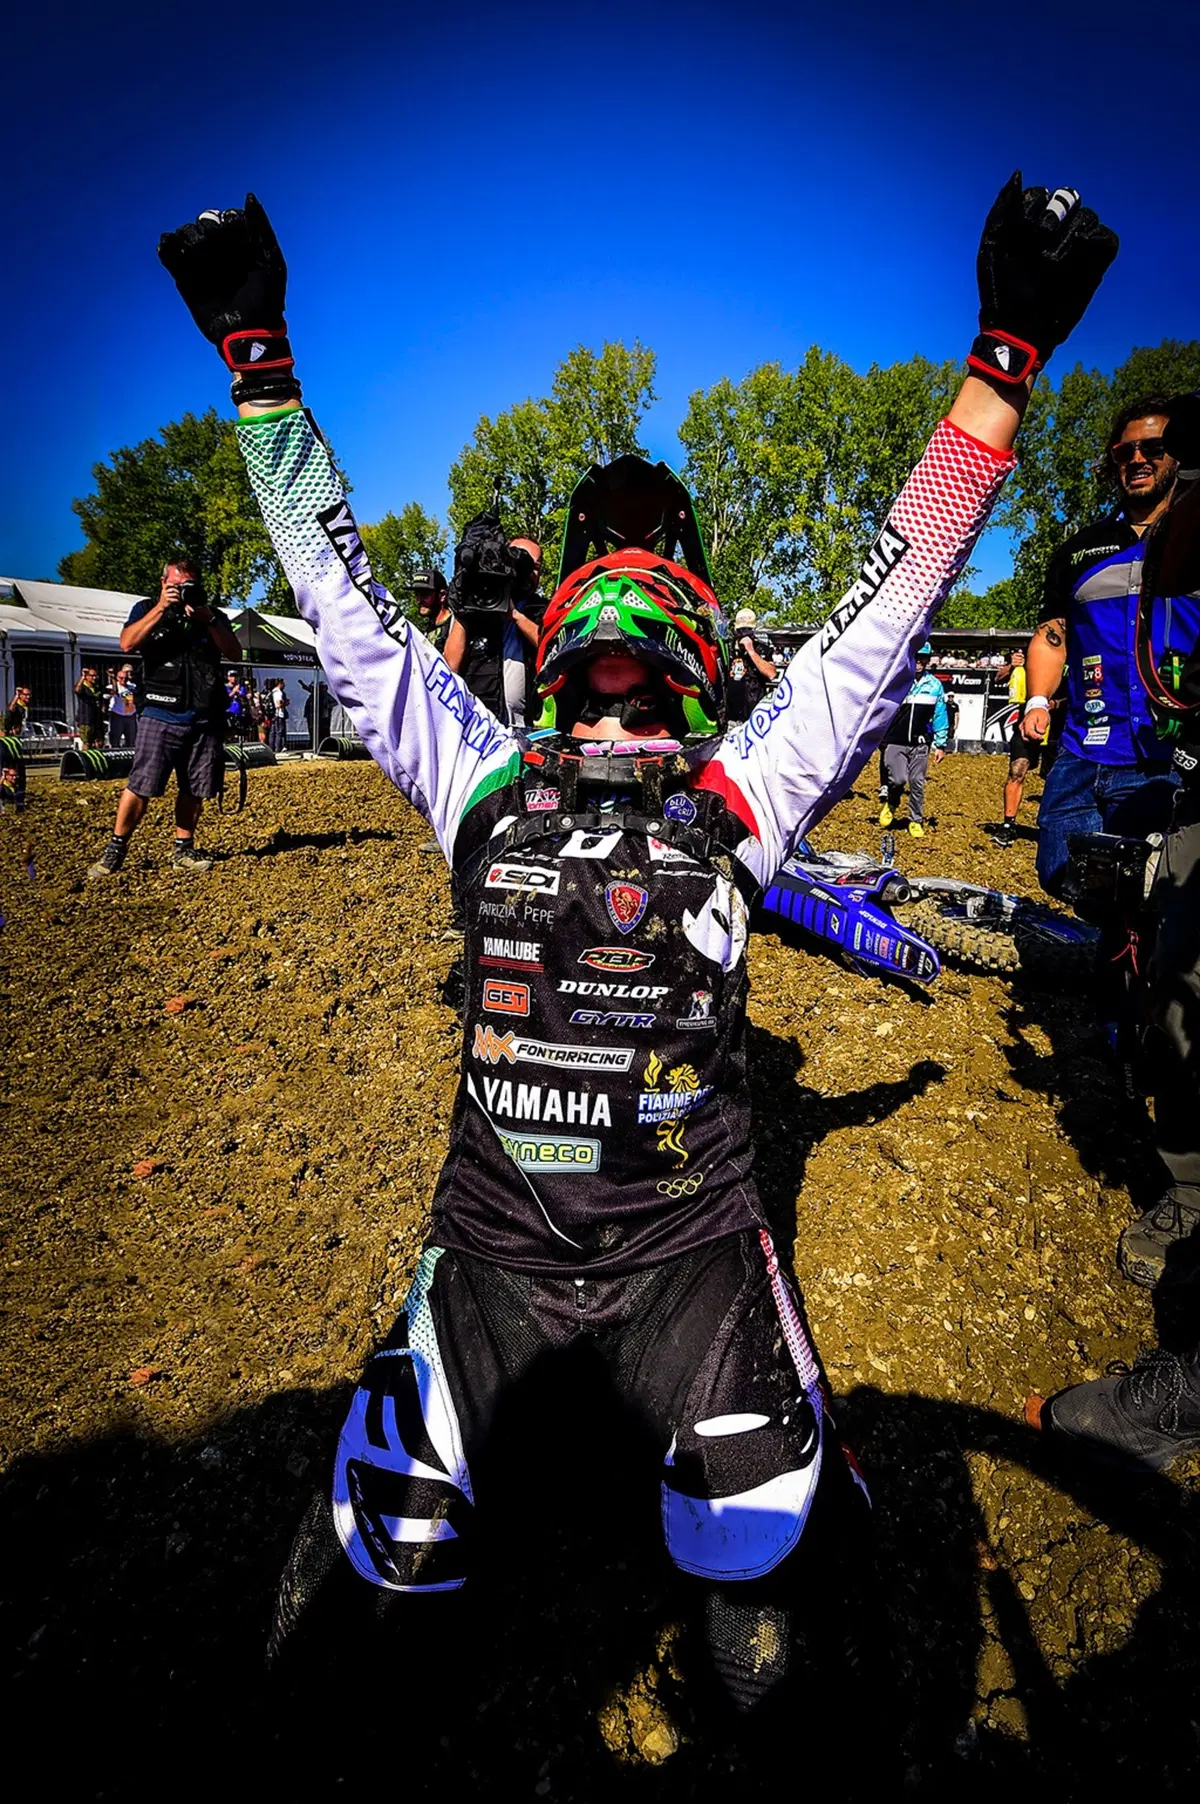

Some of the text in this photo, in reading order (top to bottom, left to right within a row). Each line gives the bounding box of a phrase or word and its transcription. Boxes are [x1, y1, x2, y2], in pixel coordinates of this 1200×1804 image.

[478, 900, 517, 920] PATRIZIA
[523, 904, 556, 925] PEPE
[483, 936, 541, 962] YAMALUBE
[487, 988, 526, 1007] GET
[556, 979, 669, 1000] DUNLOP
[568, 1008, 658, 1029] GYTR
[472, 1023, 627, 1066] MX FONTARACING
[482, 1075, 613, 1128] YAMAHA
[638, 1091, 692, 1111] FIAMME
[637, 1110, 677, 1124] POLIZIA
